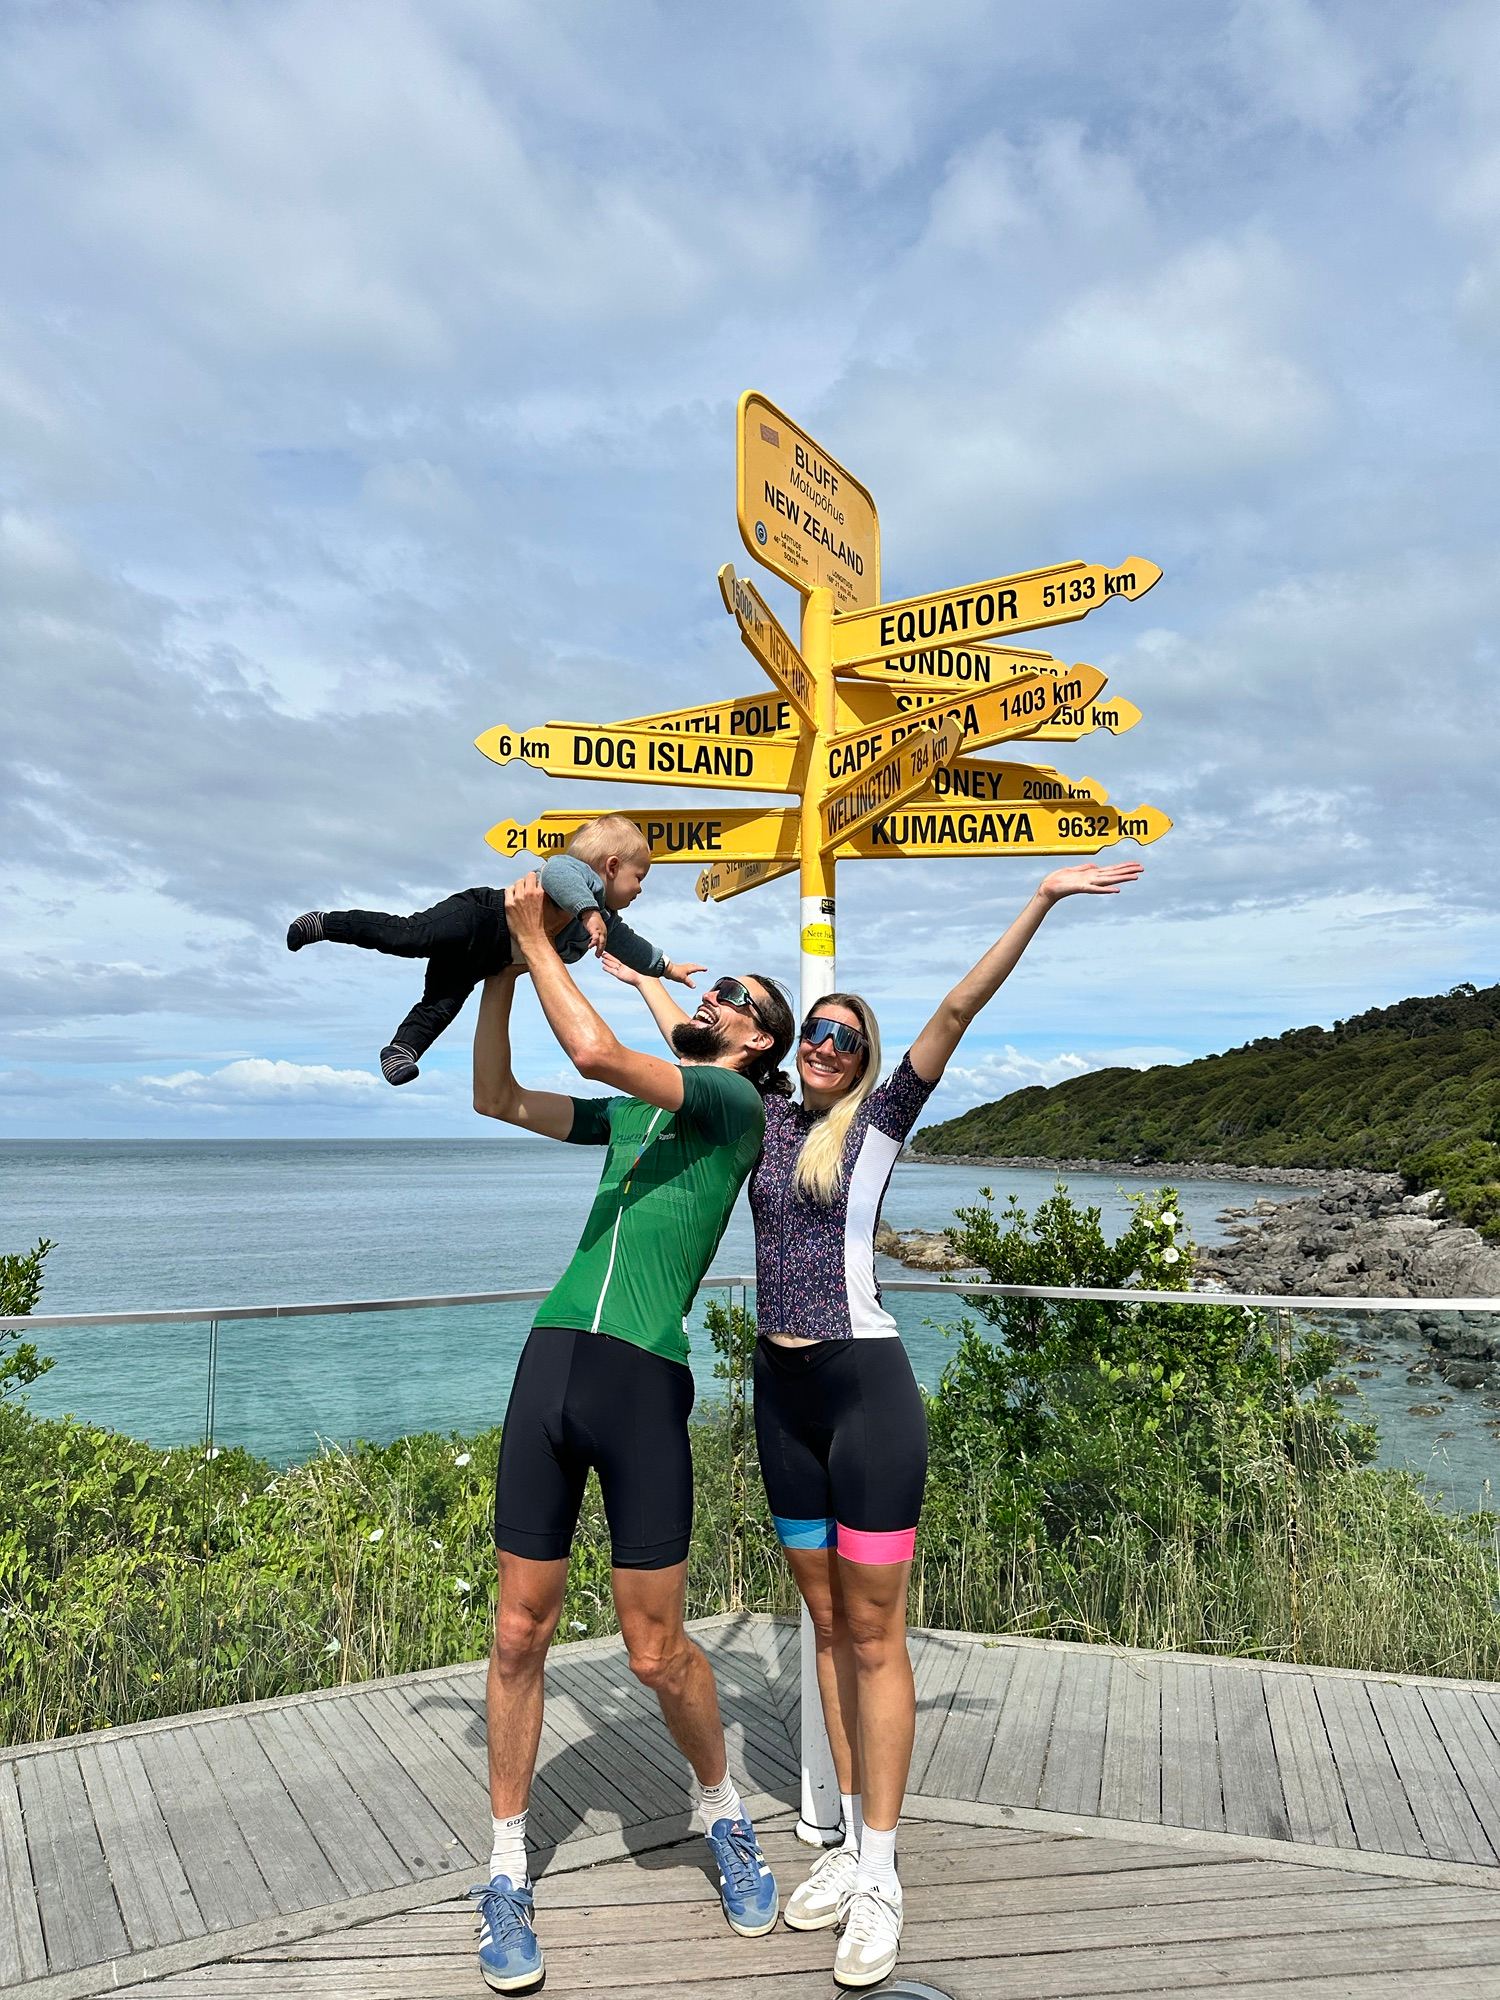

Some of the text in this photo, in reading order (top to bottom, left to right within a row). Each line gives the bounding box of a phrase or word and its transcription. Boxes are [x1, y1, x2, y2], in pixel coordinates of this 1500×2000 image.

[795, 443, 838, 496] BLUFF
[764, 480, 864, 577] NEW ZEALAND
[781, 530, 802, 552] LATITUDE
[783, 551, 799, 567] SOUTH
[787, 545, 796, 556] min
[831, 569, 853, 592] LONGITUDE
[880, 572, 1136, 647] EQUATOR 5133 km
[731, 577, 811, 711] 15008 km NEW YORK
[1000, 686, 1046, 721] 1403
[1053, 679, 1082, 706] km
[730, 701, 791, 736] POLE
[1042, 706, 1119, 727] 250 km
[499, 735, 754, 777] 6 km DOG ISLAND
[827, 735, 948, 837] WELLINGTON 784 km
[1023, 780, 1063, 800] 2000
[1068, 784, 1091, 799] km
[506, 821, 721, 851] 21 km PUKE
[871, 813, 1148, 845] KUMAGAYA 9632 km
[701, 873, 720, 894] 35 km
